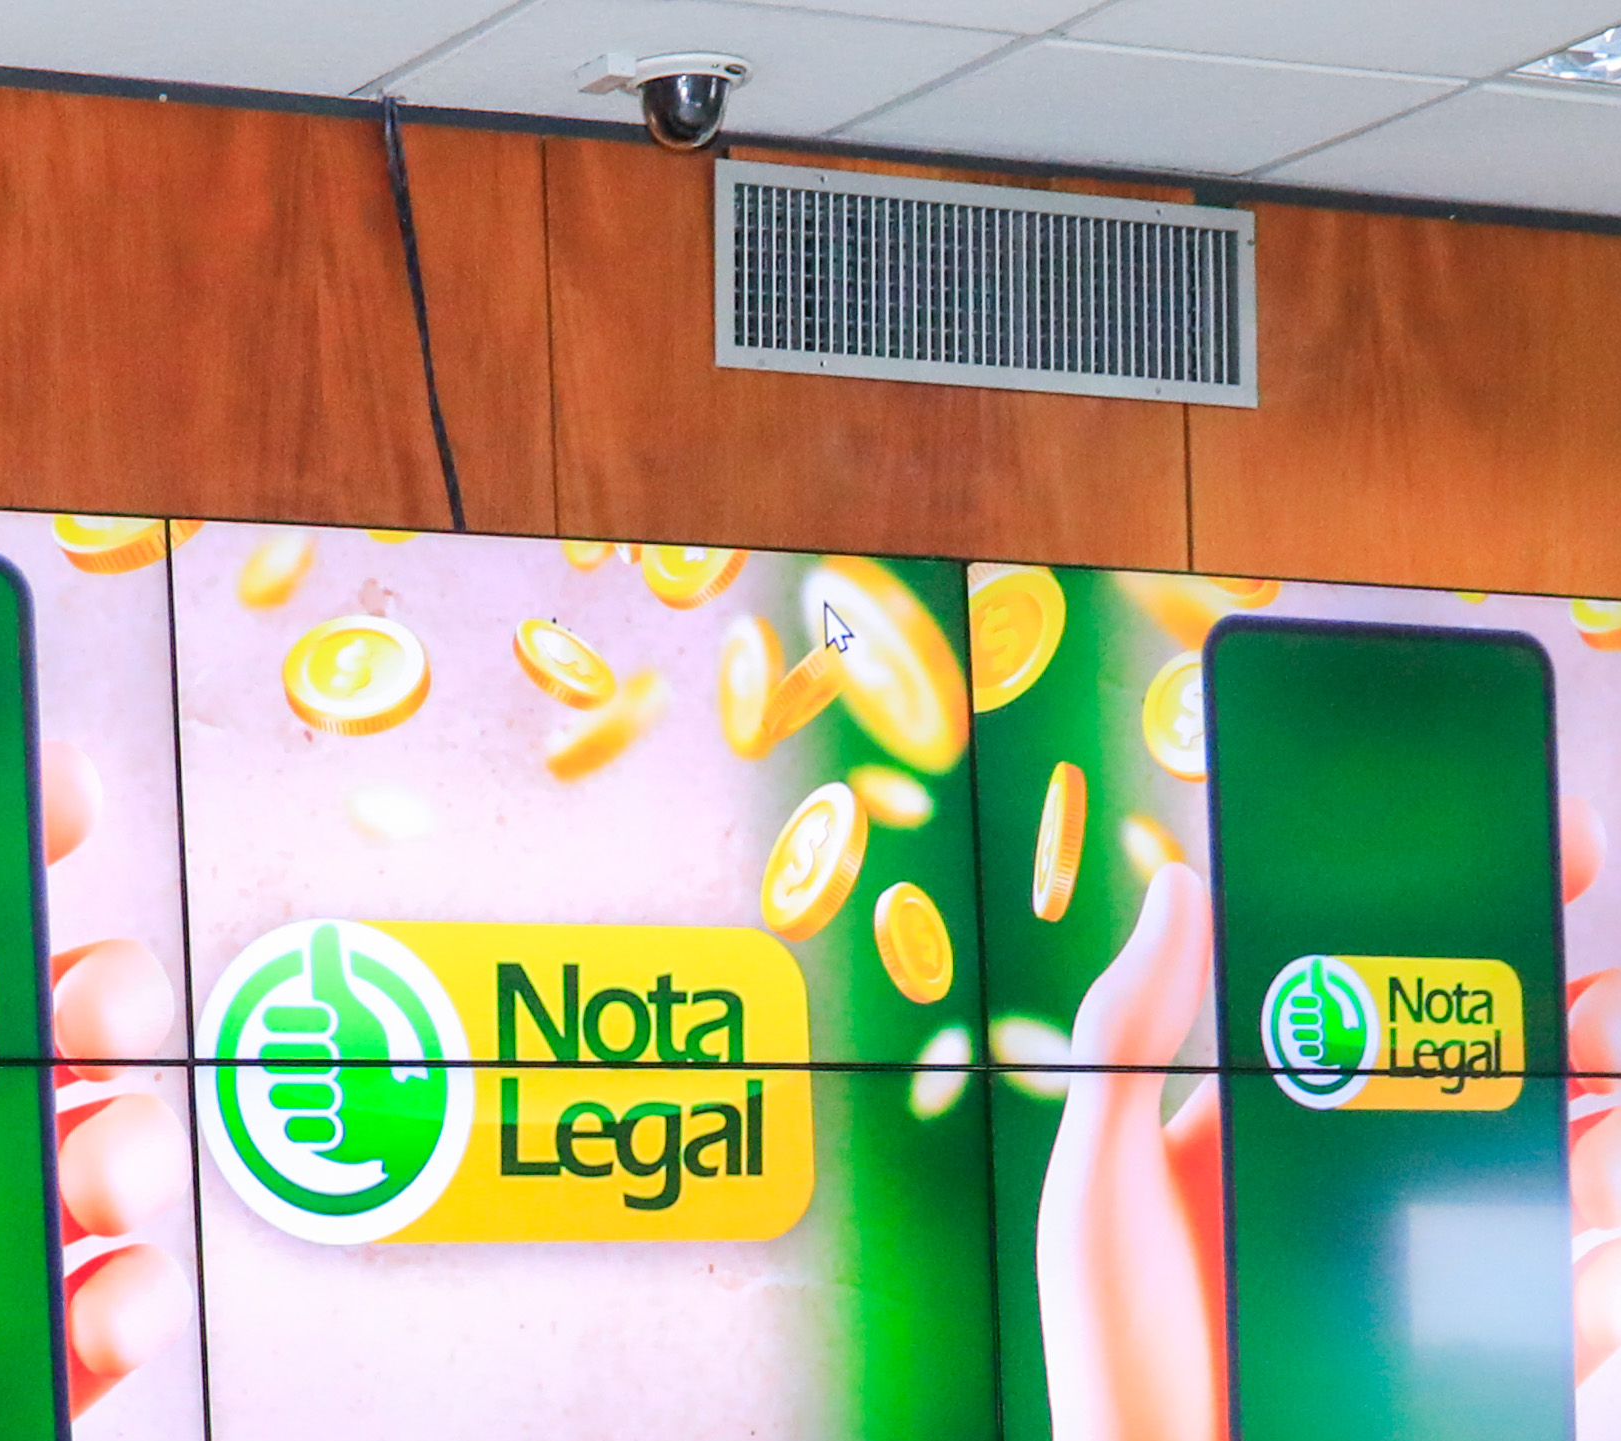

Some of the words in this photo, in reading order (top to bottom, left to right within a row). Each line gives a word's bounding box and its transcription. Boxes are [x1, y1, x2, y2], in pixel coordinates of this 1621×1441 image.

[496, 962, 744, 1063] Nota
[1388, 976, 1493, 1025] Nota
[1389, 1027, 1502, 1094] Legal
[499, 1076, 763, 1211] Legal
